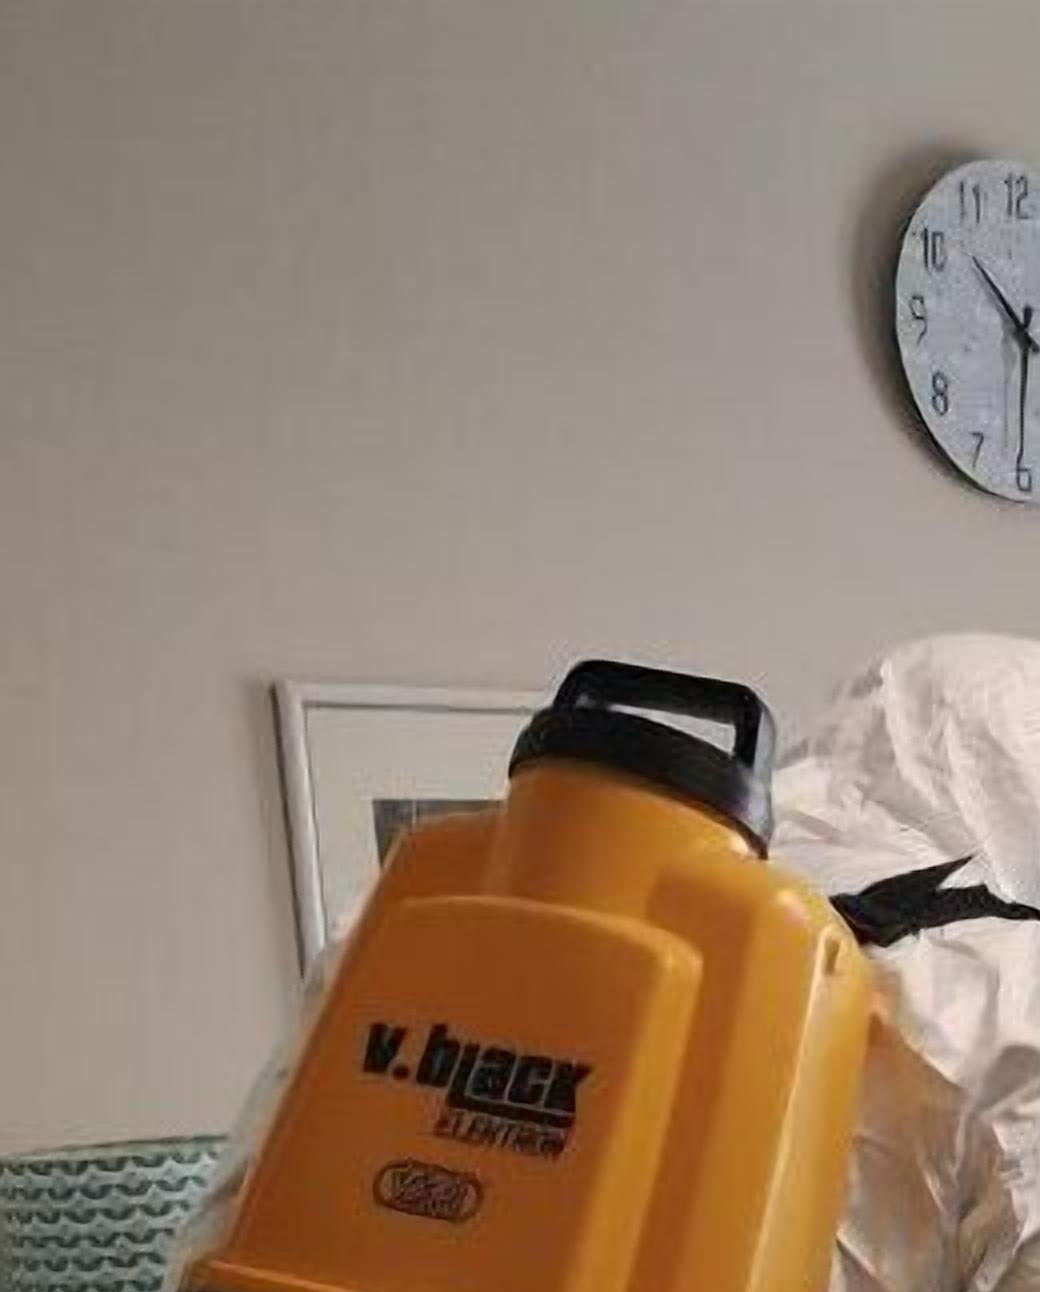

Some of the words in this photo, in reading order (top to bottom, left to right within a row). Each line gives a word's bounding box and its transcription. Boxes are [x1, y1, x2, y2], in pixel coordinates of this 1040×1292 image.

[959, 181, 981, 224] 11
[1004, 172, 1031, 220] 12
[921, 227, 946, 272] 10
[908, 295, 928, 346] 9
[931, 371, 948, 416] 8
[969, 432, 985, 468] 7
[1015, 450, 1032, 493] 6
